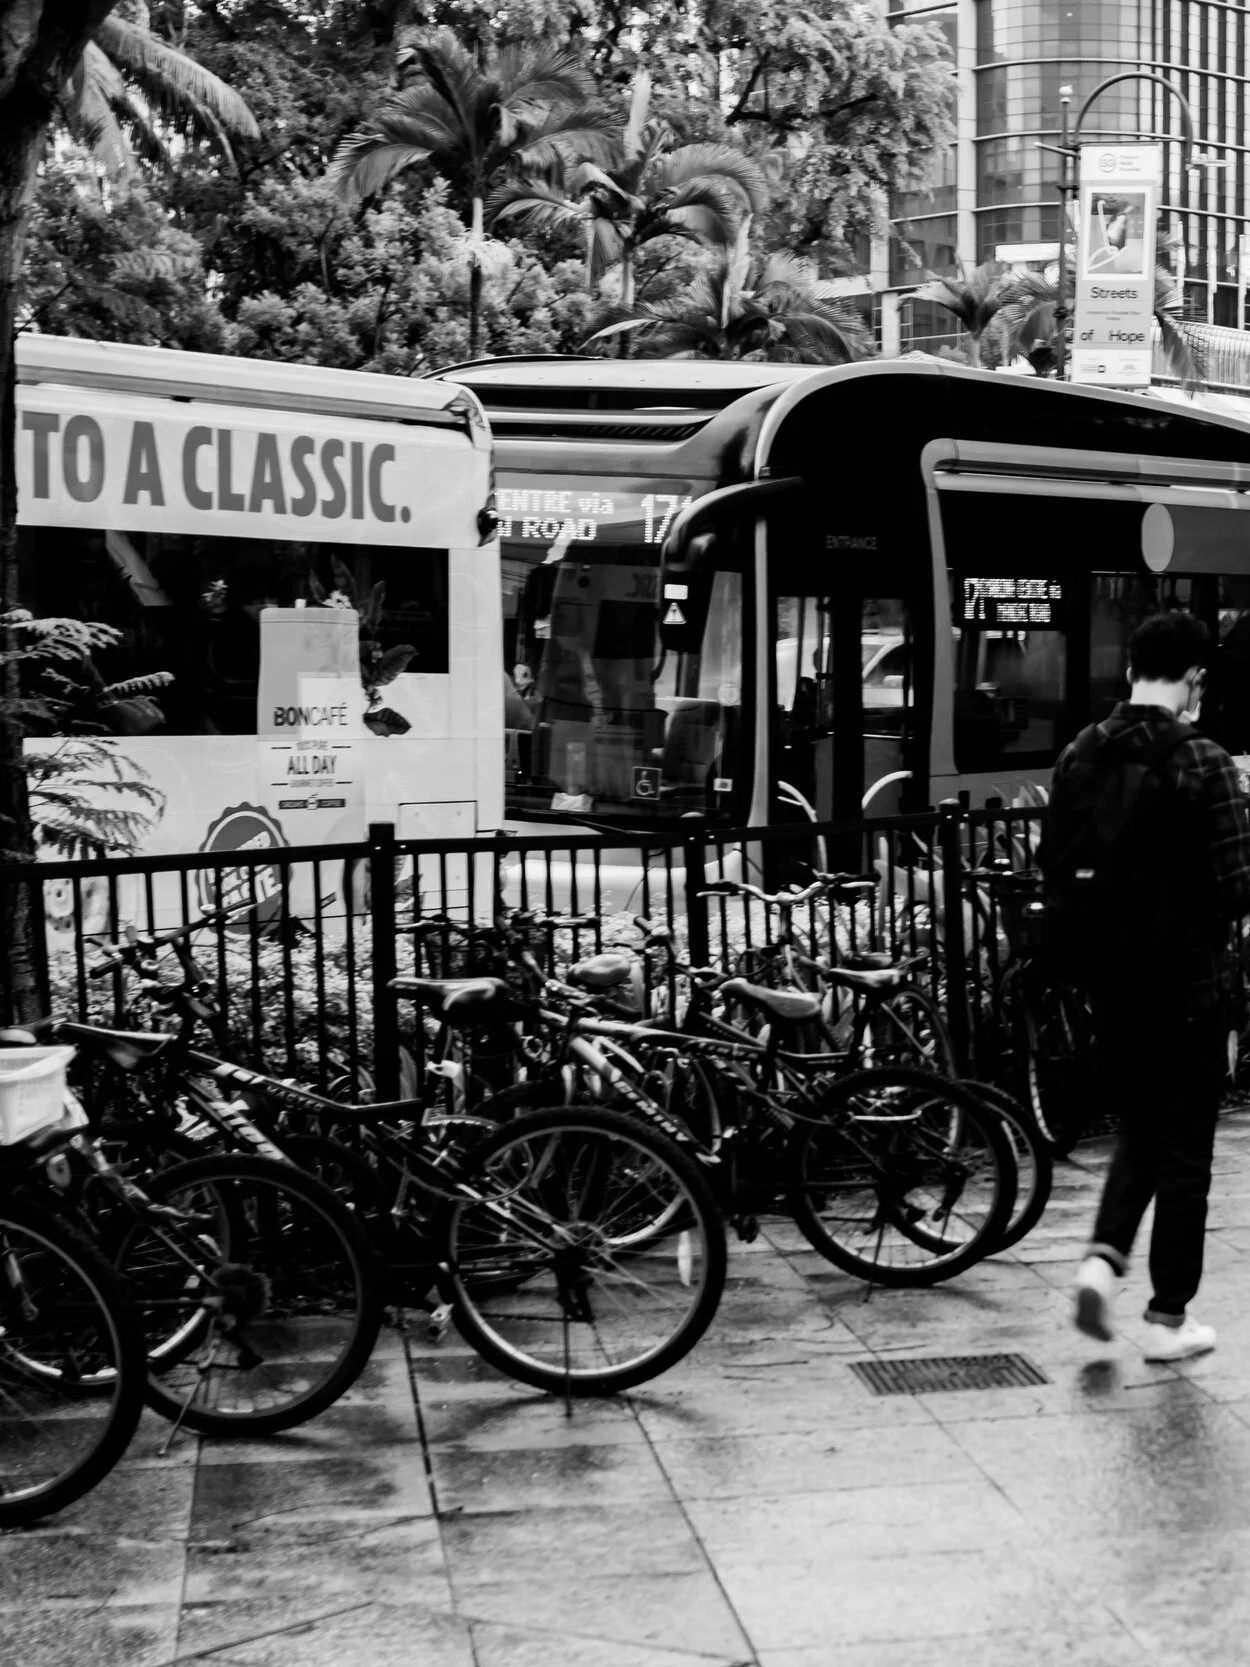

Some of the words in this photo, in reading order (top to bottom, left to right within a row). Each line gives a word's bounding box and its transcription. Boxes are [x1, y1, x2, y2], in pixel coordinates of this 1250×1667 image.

[1090, 286, 1139, 299] Streets
[1079, 328, 1095, 341] of
[1107, 329, 1145, 346] Hope
[22, 411, 105, 504] TO
[123, 421, 166, 507] A
[181, 425, 412, 524] CLASSIC.
[521, 516, 598, 541] ROAD
[273, 701, 349, 727] BONCAFÉ
[286, 755, 310, 775] ALL
[312, 754, 337, 775] DAY
